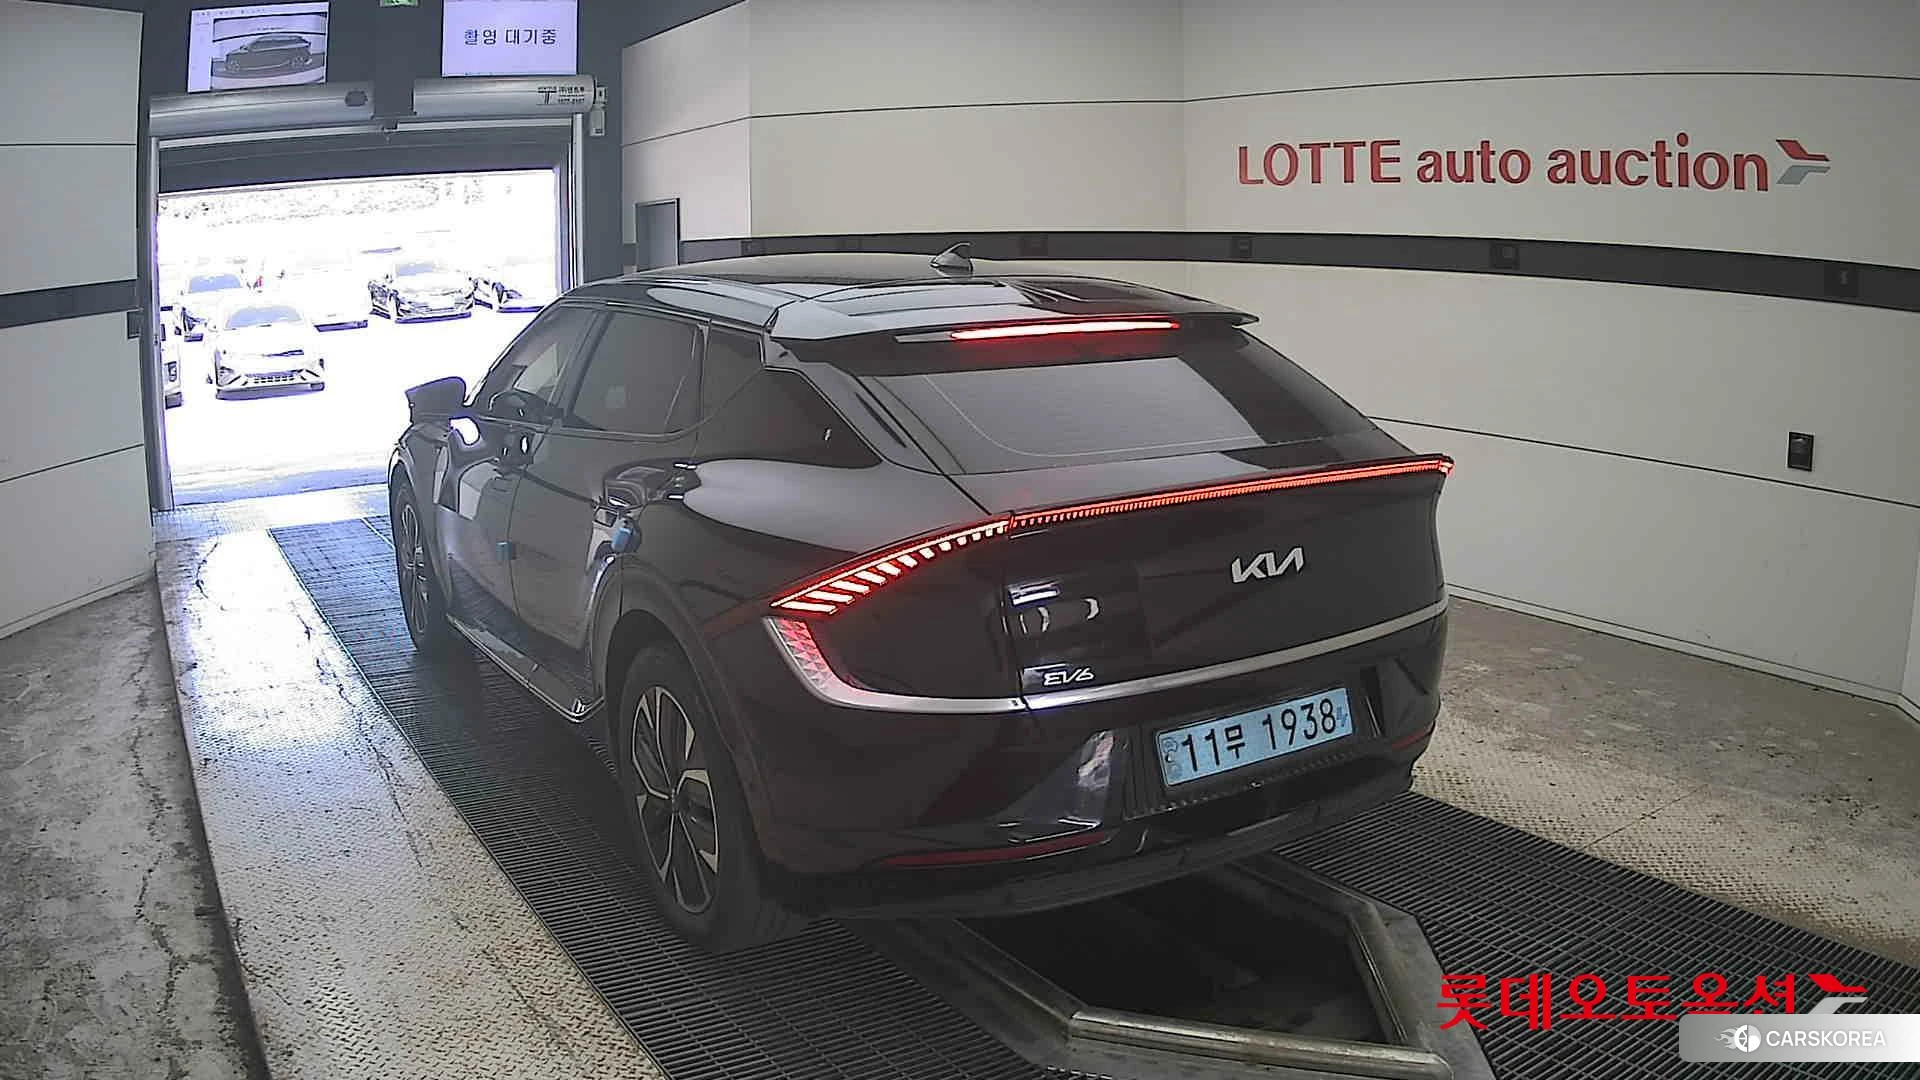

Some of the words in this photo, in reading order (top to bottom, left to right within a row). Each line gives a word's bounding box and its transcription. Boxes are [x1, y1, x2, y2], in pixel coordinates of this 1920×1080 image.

[505, 28, 557, 45] 대기중
[1238, 139, 1401, 187] LOTTE
[1416, 139, 1532, 184] auto
[1546, 132, 1769, 192] auction
[1230, 546, 1305, 583] KIA
[1043, 667, 1095, 687] EV6
[1181, 723, 1246, 772] 11무
[1262, 698, 1337, 750] 1938
